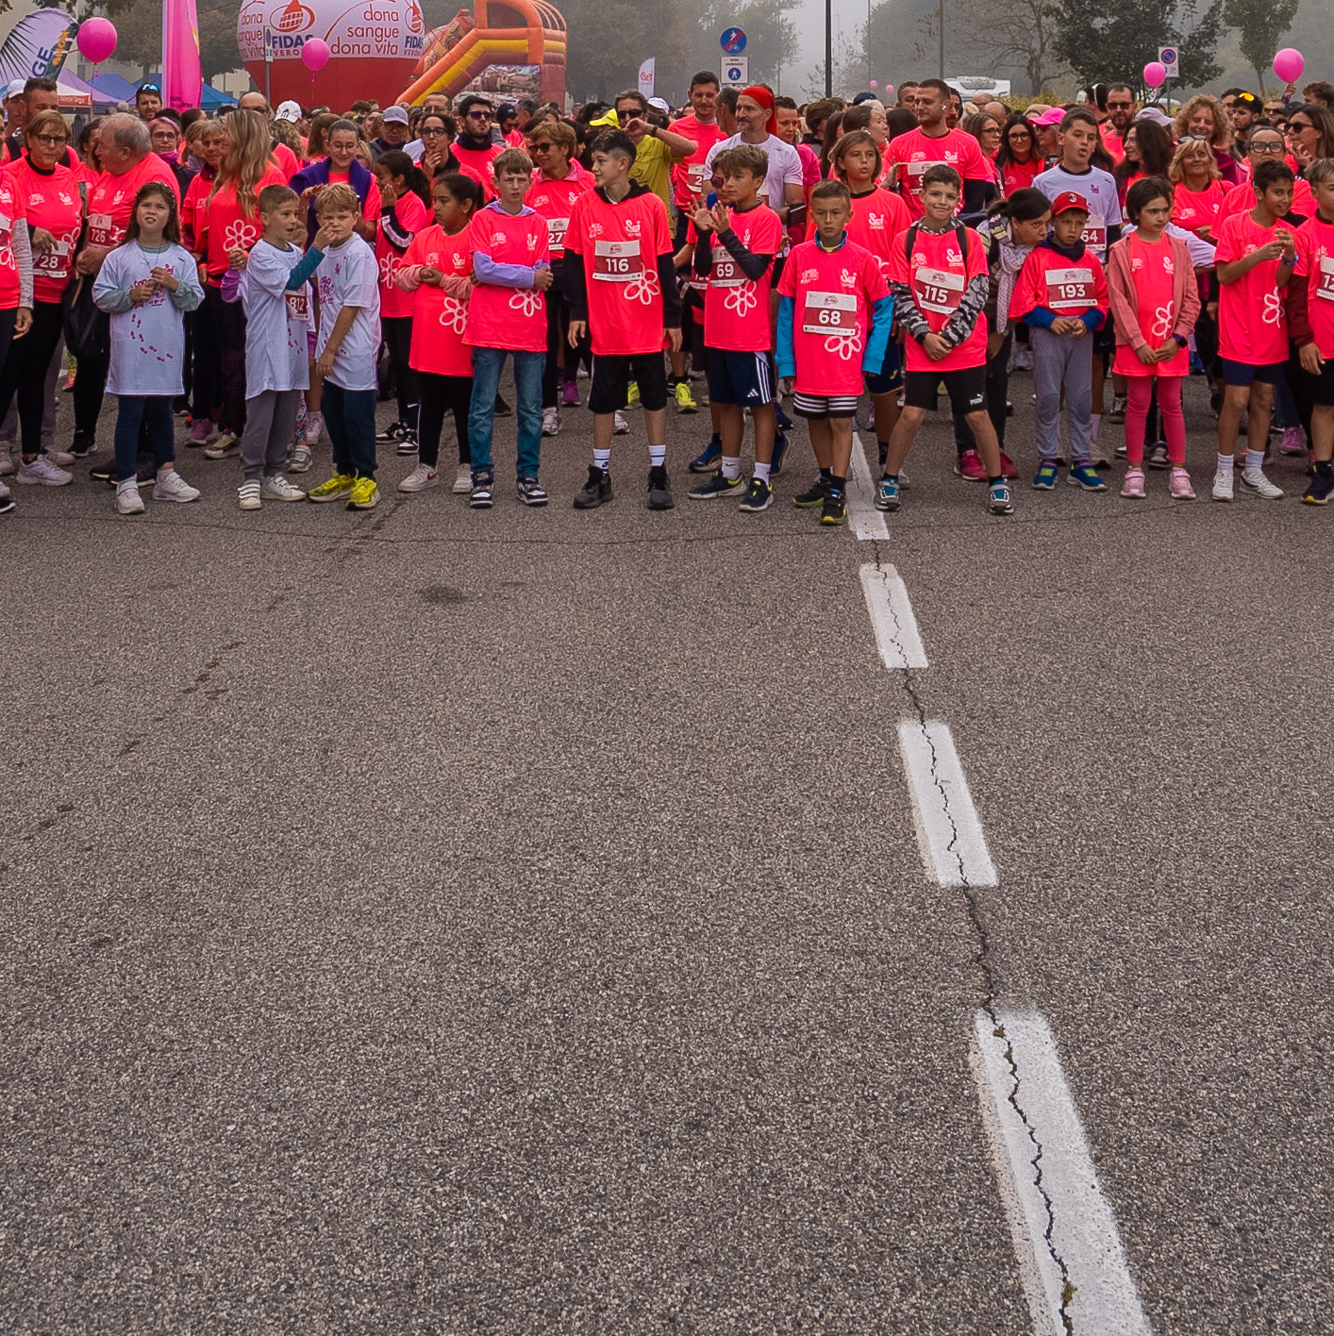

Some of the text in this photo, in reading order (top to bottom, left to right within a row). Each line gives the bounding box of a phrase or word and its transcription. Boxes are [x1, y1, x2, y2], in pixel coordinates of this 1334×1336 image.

[363, 3, 399, 22] dona
[347, 25, 400, 43] sangue
[330, 38, 371, 55] dona
[375, 38, 398, 55] vita
[548, 231, 567, 244] 27
[39, 255, 59, 269] 28
[605, 258, 630, 272] 116
[716, 263, 734, 277] 69
[924, 285, 949, 304] 115
[1058, 284, 1086, 299] 193
[818, 310, 841, 325] 68
